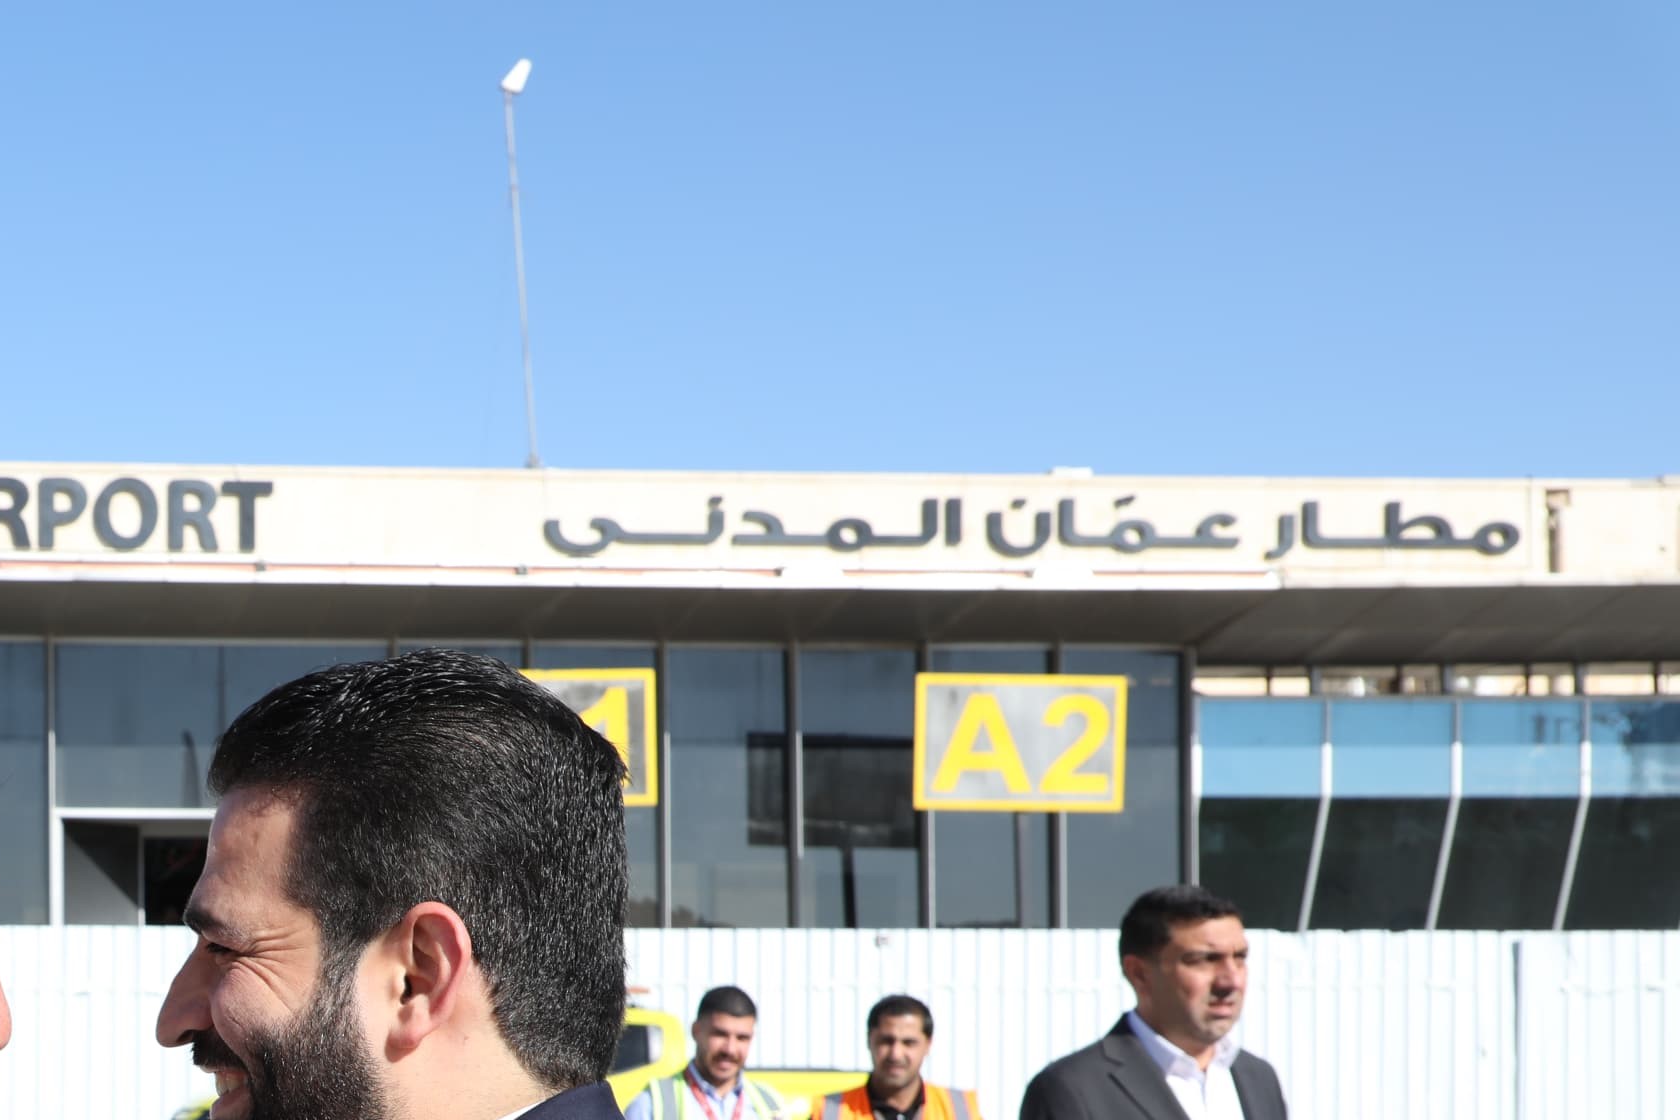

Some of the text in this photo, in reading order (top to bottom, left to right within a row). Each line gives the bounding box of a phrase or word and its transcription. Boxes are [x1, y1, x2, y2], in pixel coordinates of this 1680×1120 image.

[1264, 501, 1521, 561] مطار
[578, 685, 631, 791] 1
[931, 691, 1112, 795] A2
